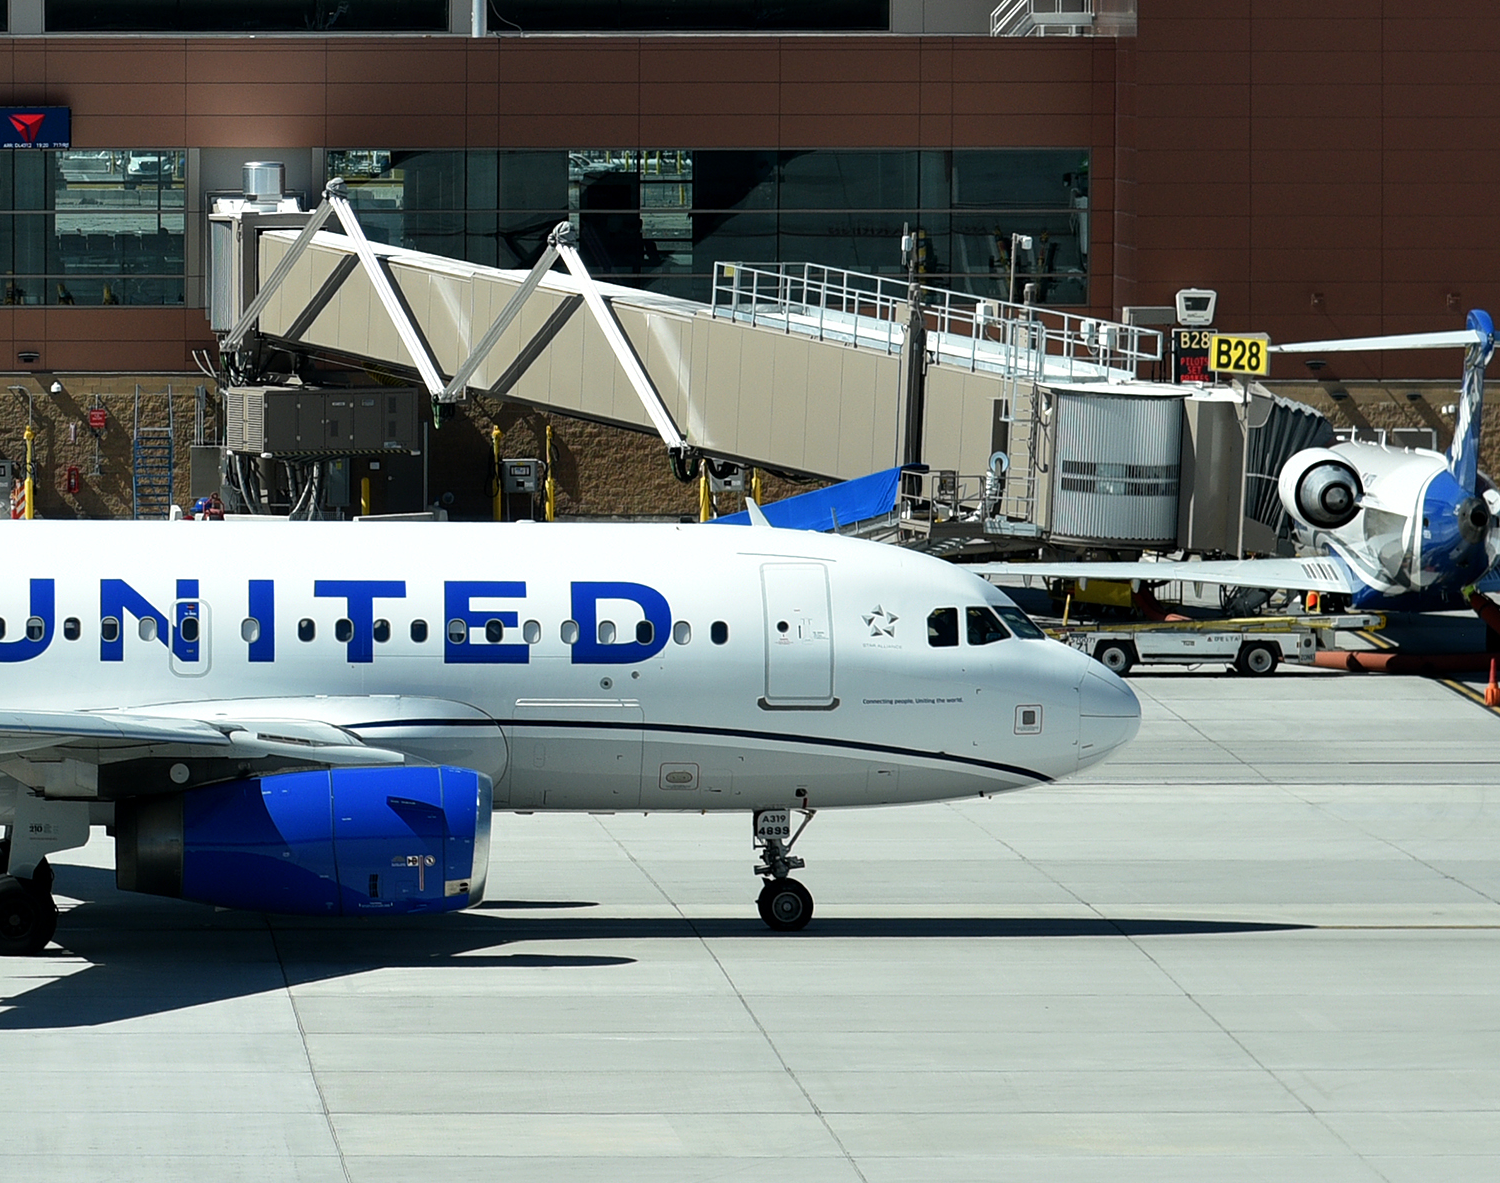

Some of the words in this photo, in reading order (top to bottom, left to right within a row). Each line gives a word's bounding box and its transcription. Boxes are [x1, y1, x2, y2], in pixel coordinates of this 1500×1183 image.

[1180, 331, 1210, 349] B28
[1216, 338, 1260, 372] B28
[1180, 357, 1209, 366] PILOTS
[1187, 366, 1202, 374] SET
[762, 814, 786, 823] A319
[758, 826, 789, 835] 4899
